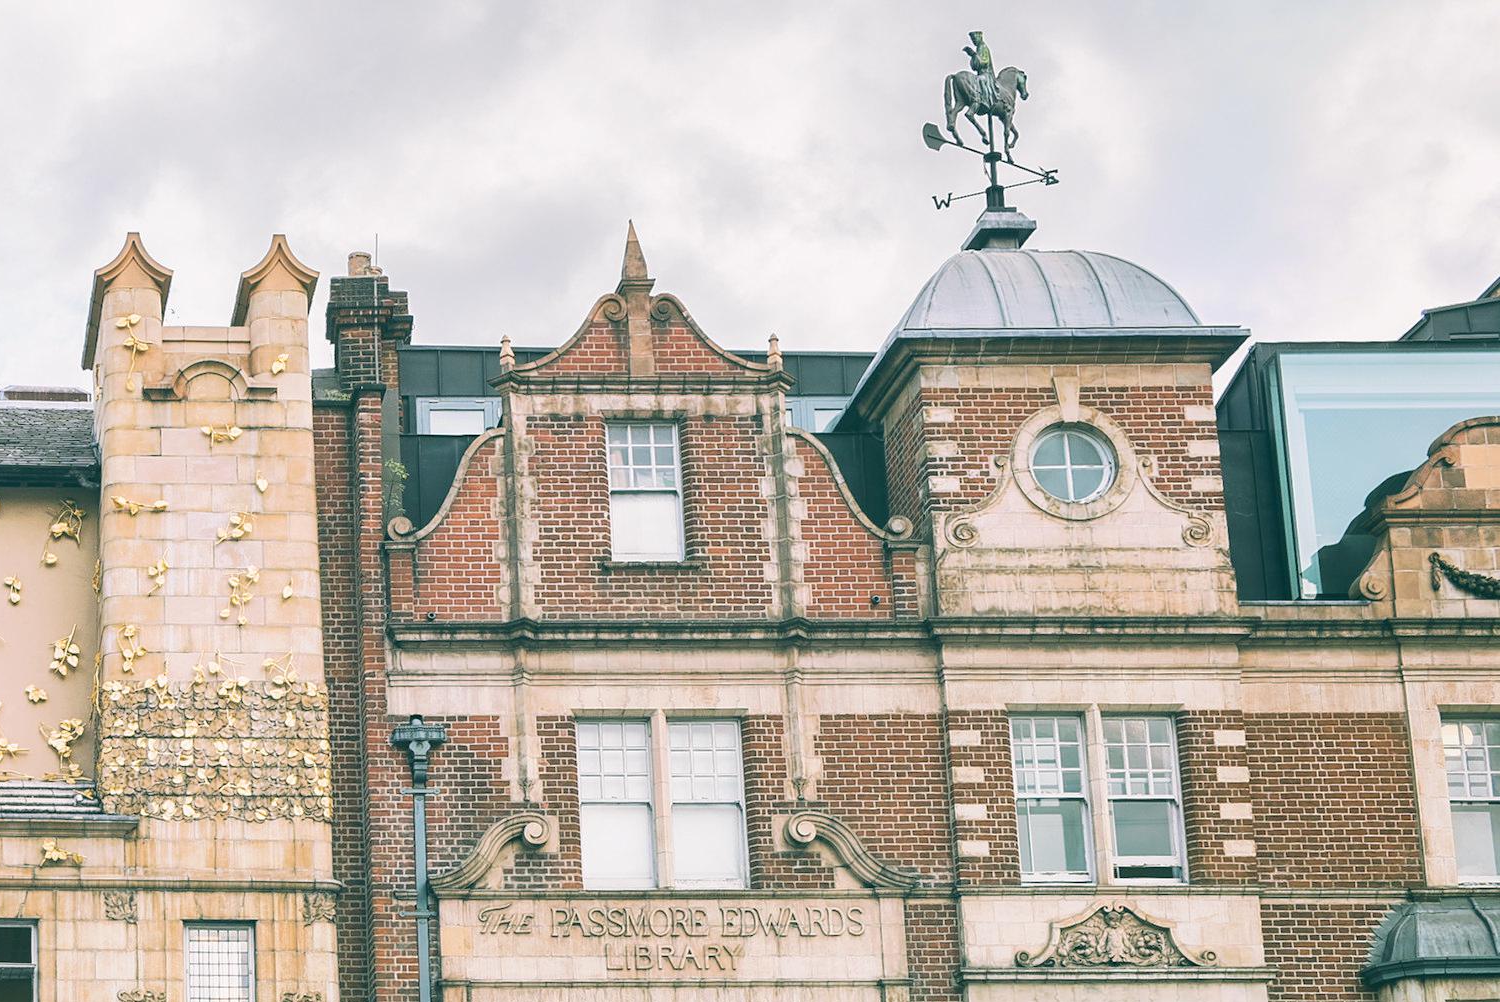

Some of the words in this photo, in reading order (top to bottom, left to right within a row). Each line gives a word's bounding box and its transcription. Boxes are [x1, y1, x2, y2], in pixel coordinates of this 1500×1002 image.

[932, 192, 952, 210] W
[551, 906, 709, 939] PASSMORE
[721, 905, 867, 938] EDWARDS
[605, 943, 746, 972] LIBRARY
